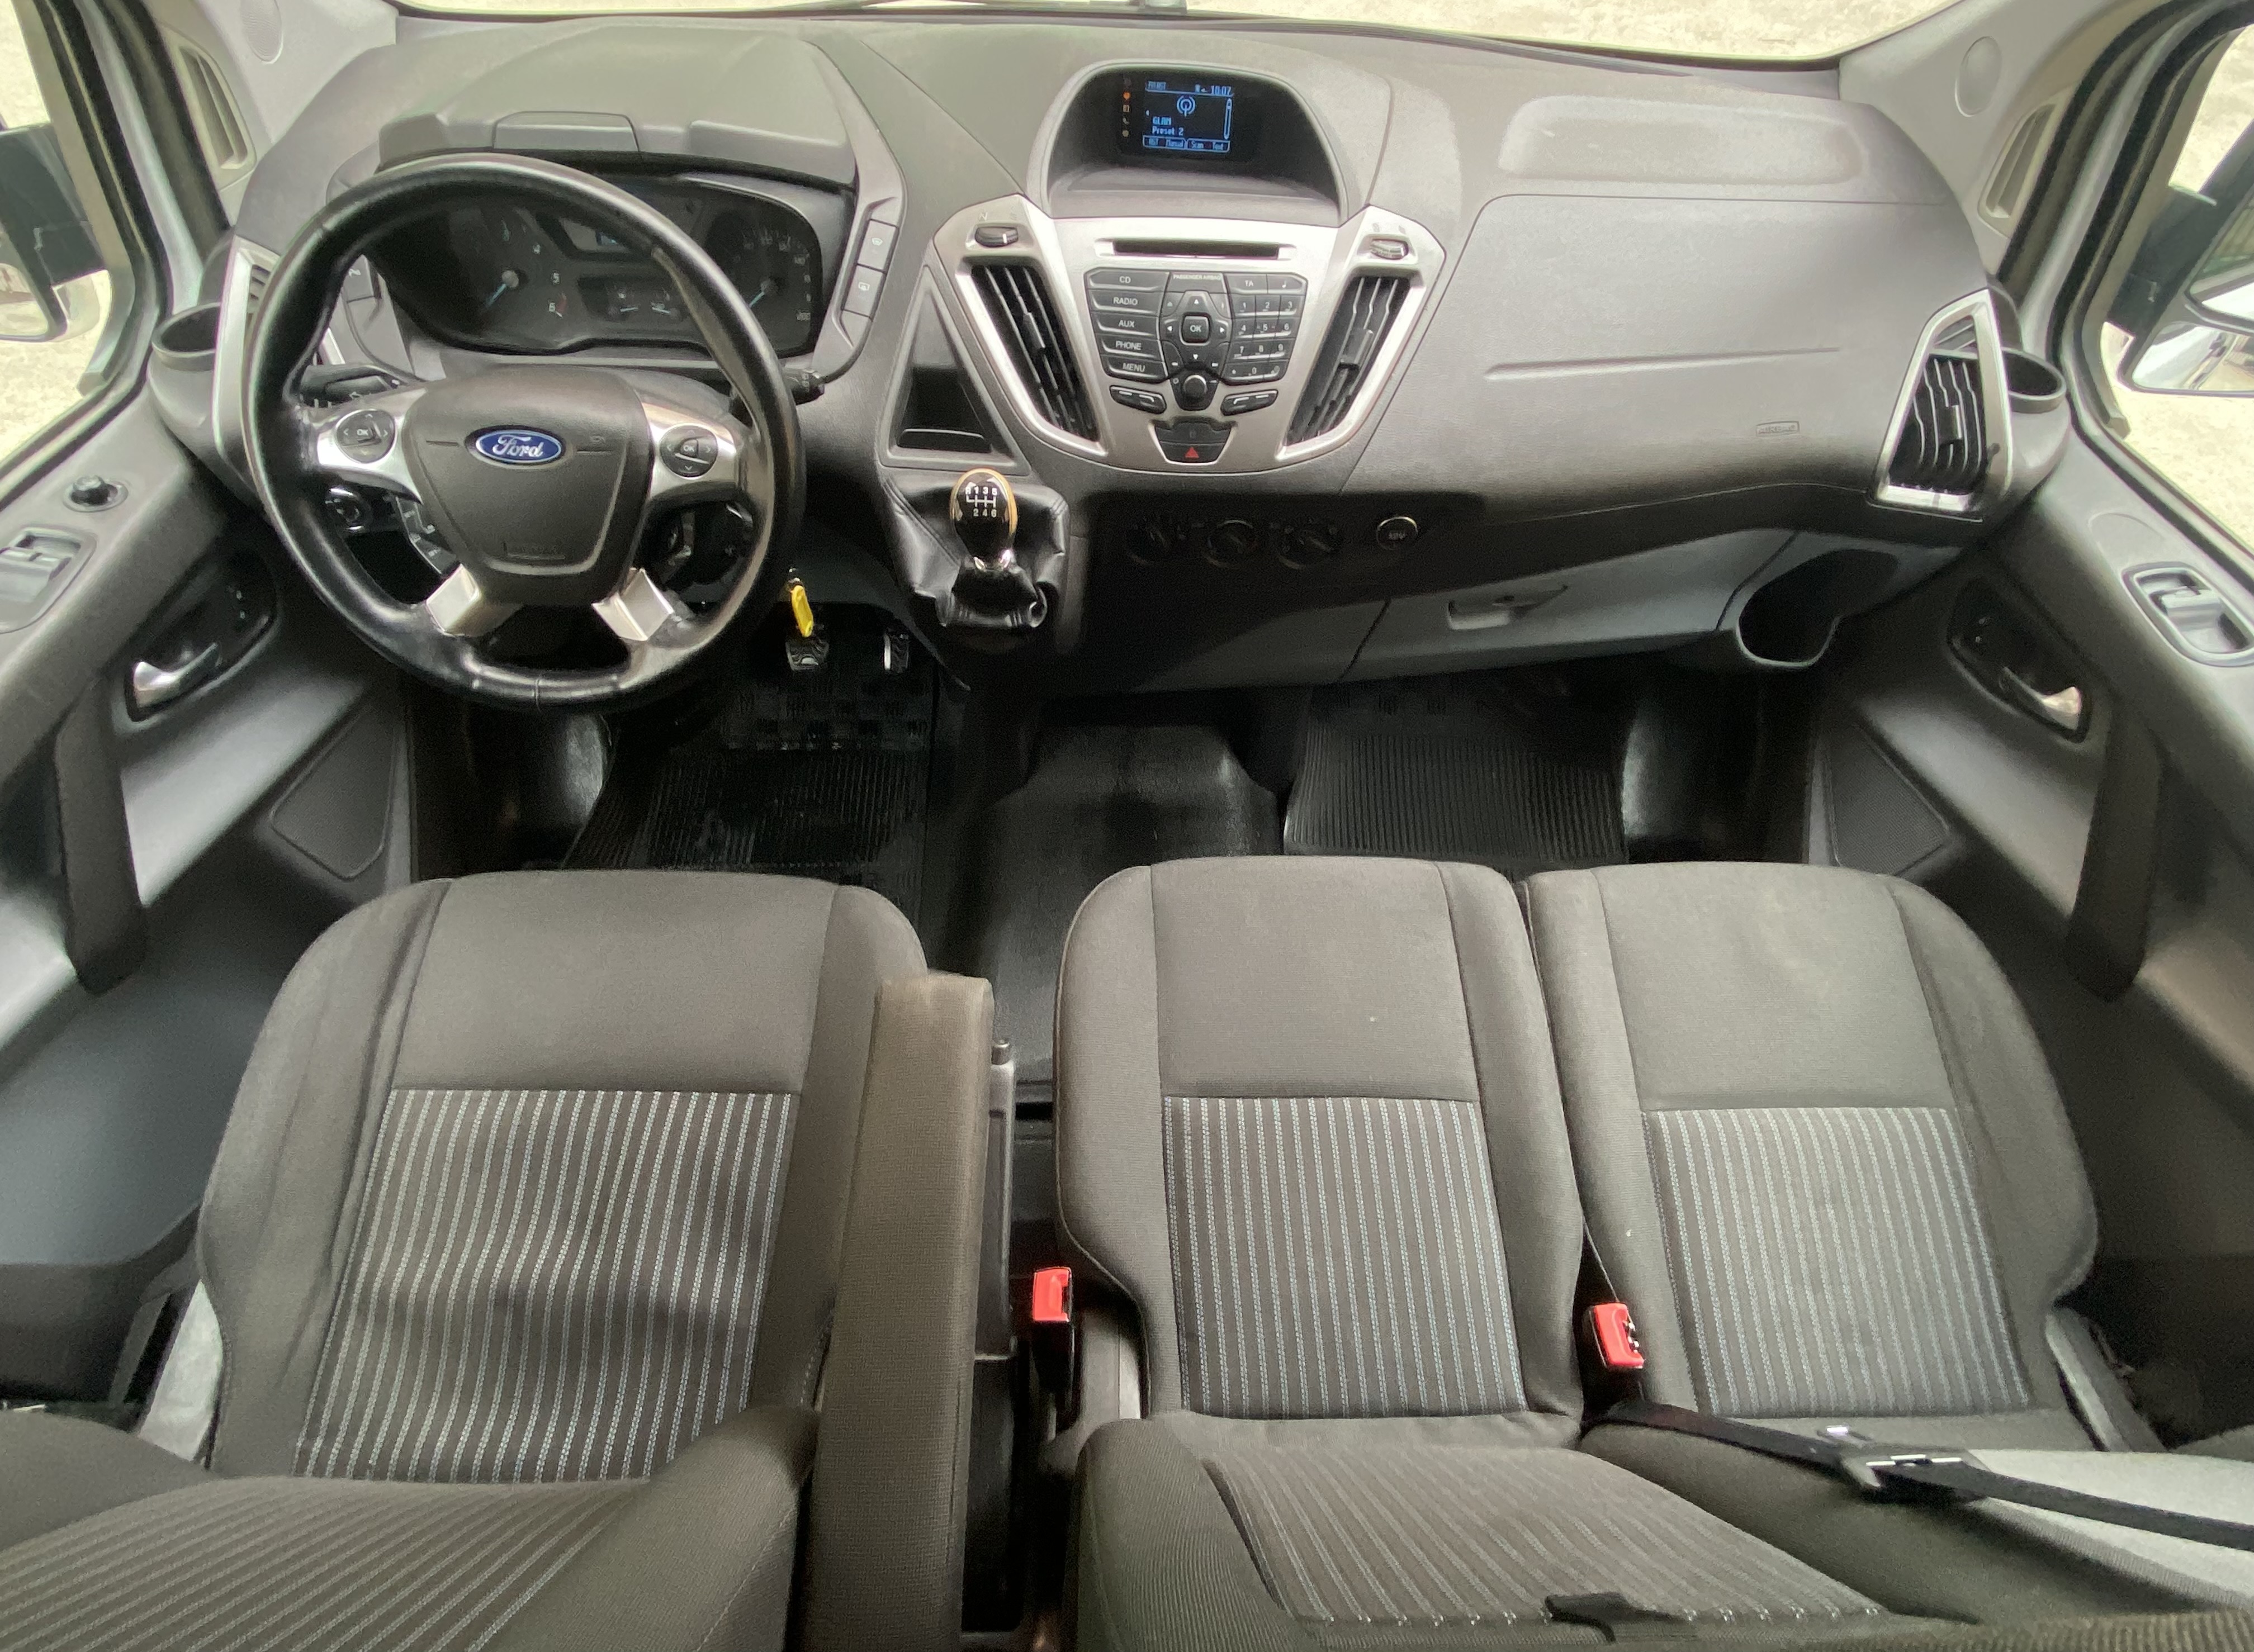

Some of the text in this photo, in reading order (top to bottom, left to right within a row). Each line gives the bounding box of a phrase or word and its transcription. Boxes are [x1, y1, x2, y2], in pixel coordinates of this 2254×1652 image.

[1153, 116, 1172, 125] GLAM
[1152, 126, 1184, 136] Preset 2
[1119, 276, 1131, 284] CD
[1113, 297, 1138, 306] RADIO
[1118, 319, 1135, 328] AUX
[1115, 340, 1142, 350] PHONE
[1239, 345, 1244, 354] 7
[1123, 363, 1146, 373] MENU
[493, 434, 544, 458] Ford
[982, 509, 988, 517] 4
[991, 509, 997, 518] 6
